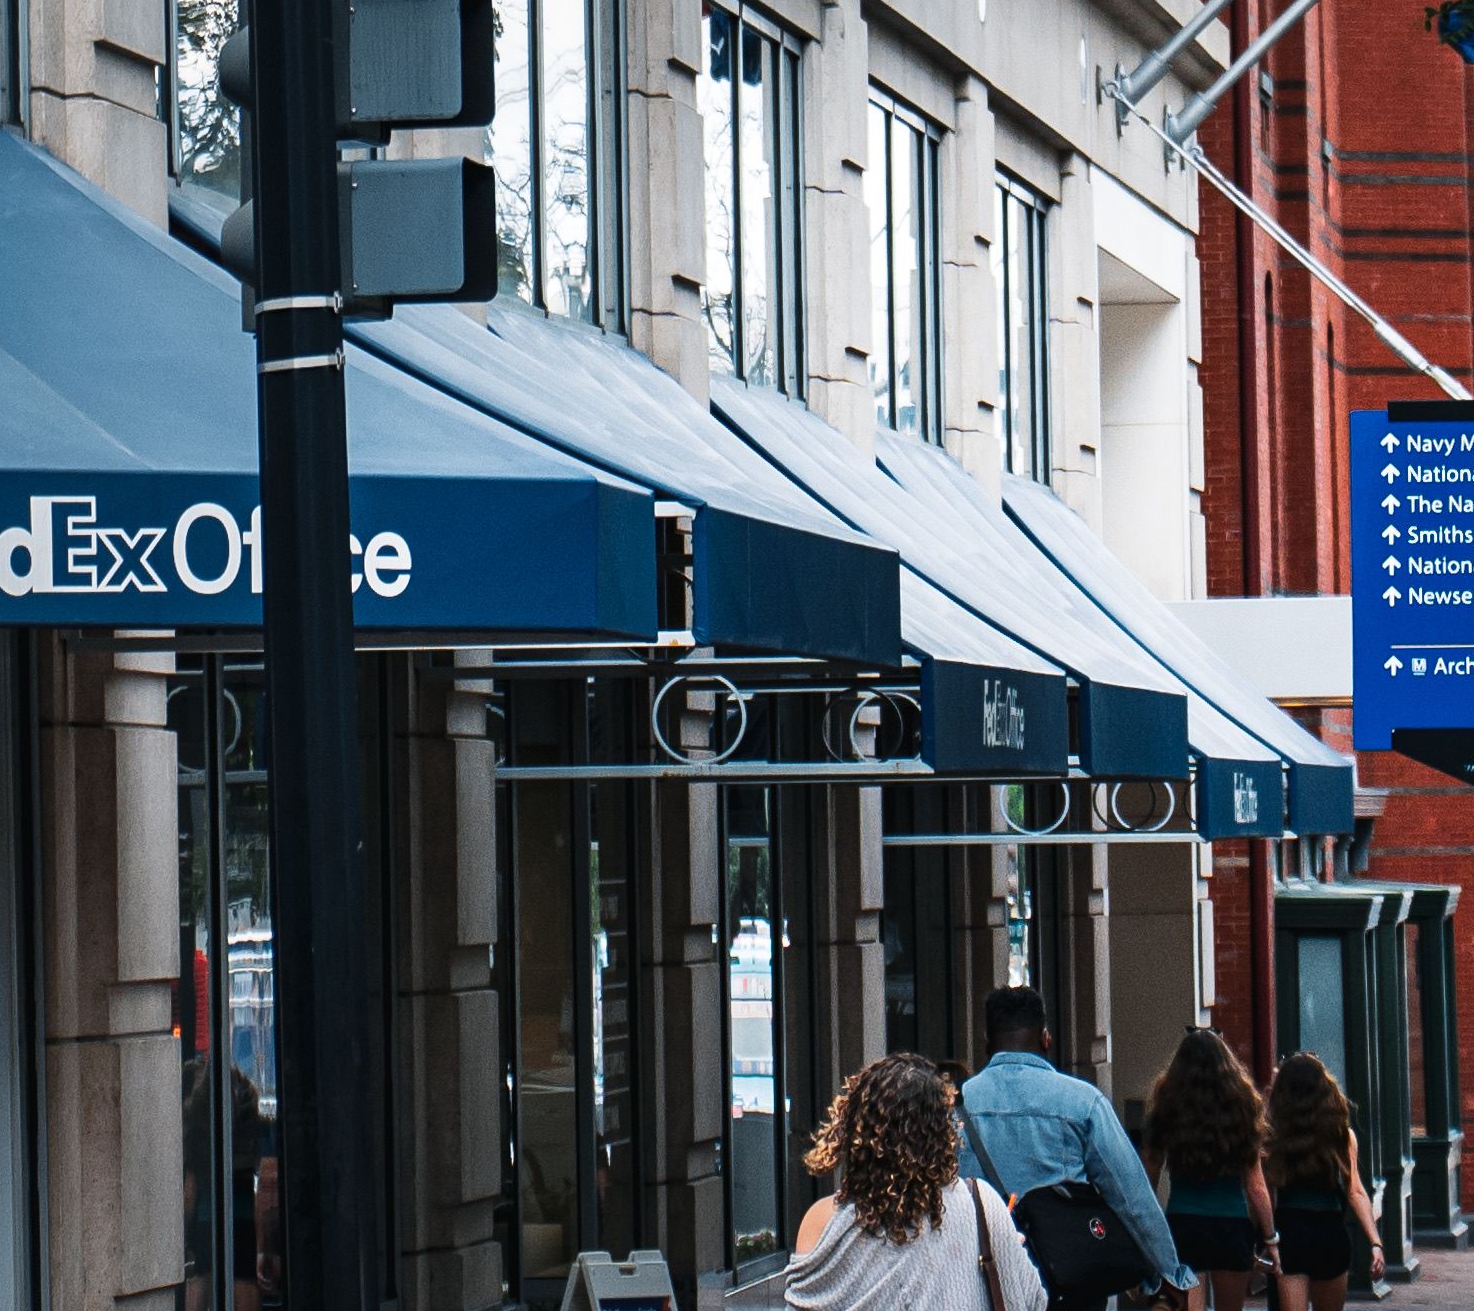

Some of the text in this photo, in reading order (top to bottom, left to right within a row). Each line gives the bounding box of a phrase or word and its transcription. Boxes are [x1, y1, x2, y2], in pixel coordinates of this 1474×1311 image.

[1407, 435, 1455, 456] Navy
[1407, 495, 1443, 513] The
[173, 502, 412, 597] Ofe
